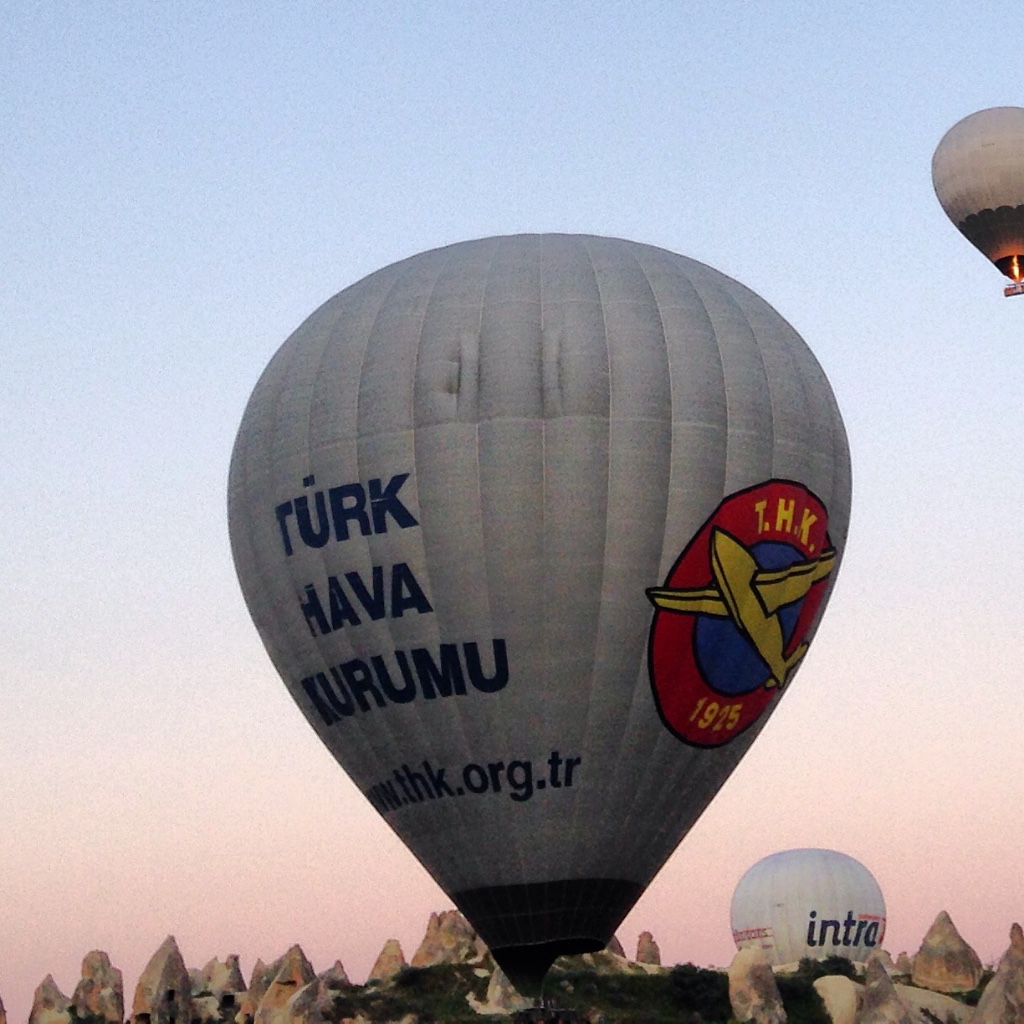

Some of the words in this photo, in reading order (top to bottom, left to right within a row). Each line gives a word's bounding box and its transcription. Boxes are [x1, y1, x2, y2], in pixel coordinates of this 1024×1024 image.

[276, 473, 419, 556] TÜRK
[300, 562, 434, 638] HAVA
[302, 638, 510, 727] KURUMU
[688, 696, 743, 732] 1925
